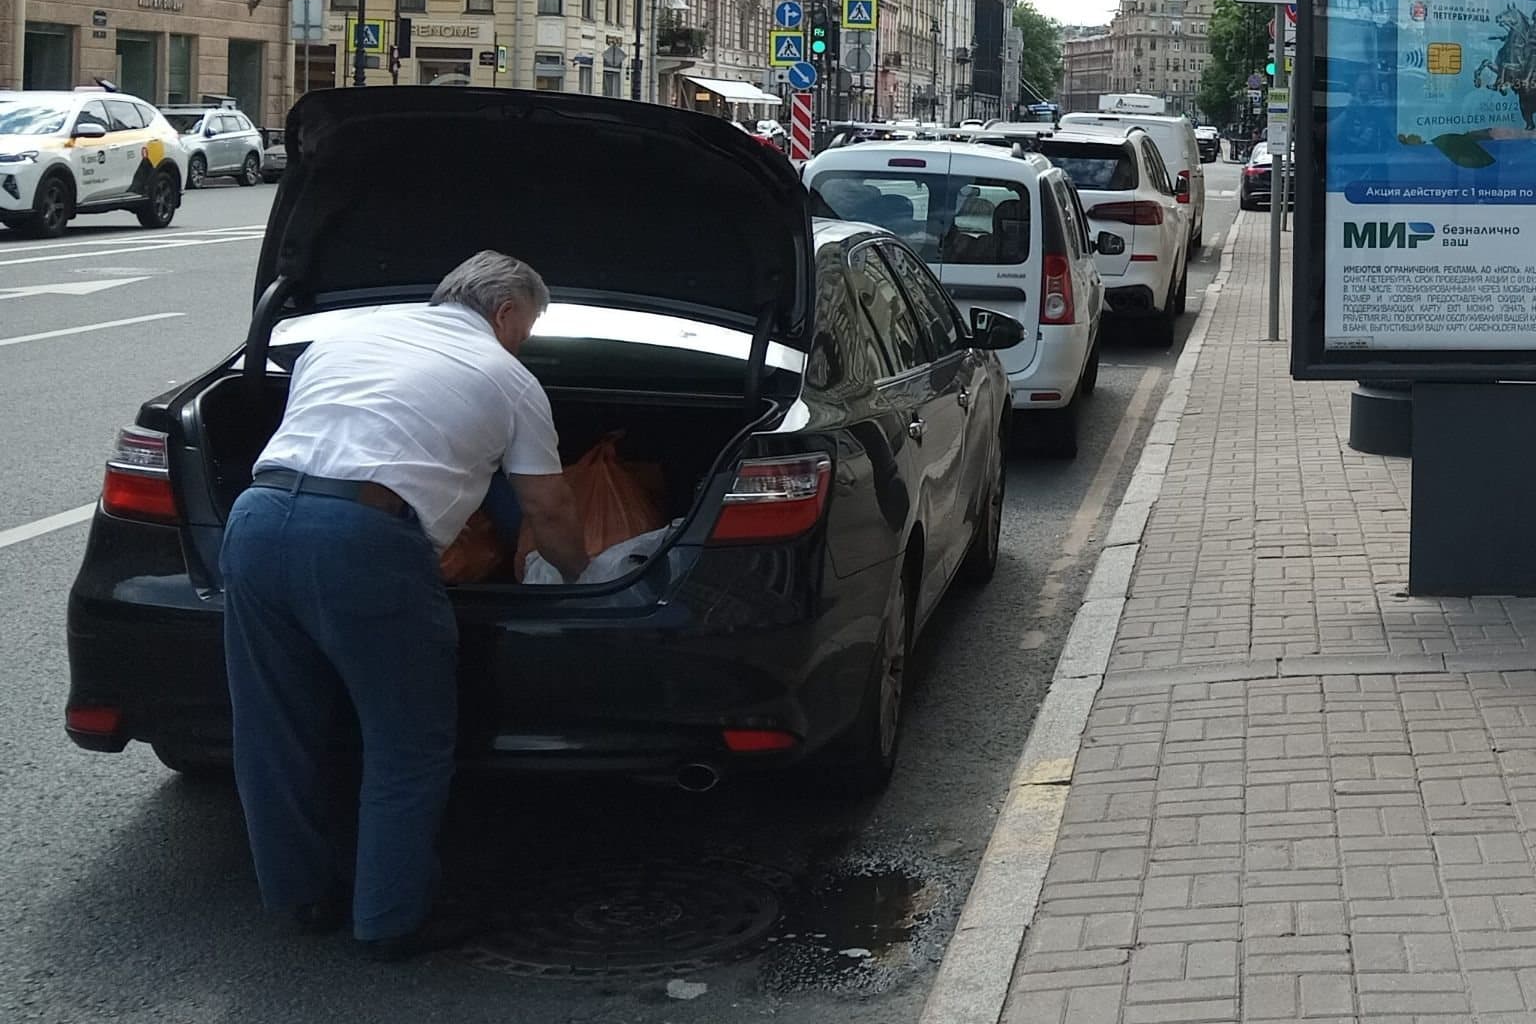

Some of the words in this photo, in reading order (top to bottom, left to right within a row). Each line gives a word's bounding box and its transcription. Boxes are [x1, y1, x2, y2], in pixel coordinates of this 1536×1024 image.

[1433, 12, 1491, 23] ПЕТЕРБУРЖЦА
[1416, 114, 1486, 126] CARDHOLDER
[1488, 114, 1516, 123] NAME
[1366, 186, 1401, 198] Акция
[1403, 187, 1459, 199] действует
[1461, 189, 1468, 197] с
[1471, 188, 1476, 197] 1
[1478, 188, 1517, 198] января
[1519, 189, 1533, 197] по
[1343, 222, 1436, 249] МИР
[1442, 224, 1520, 236] безналично
[1442, 238, 1469, 247] ваш
